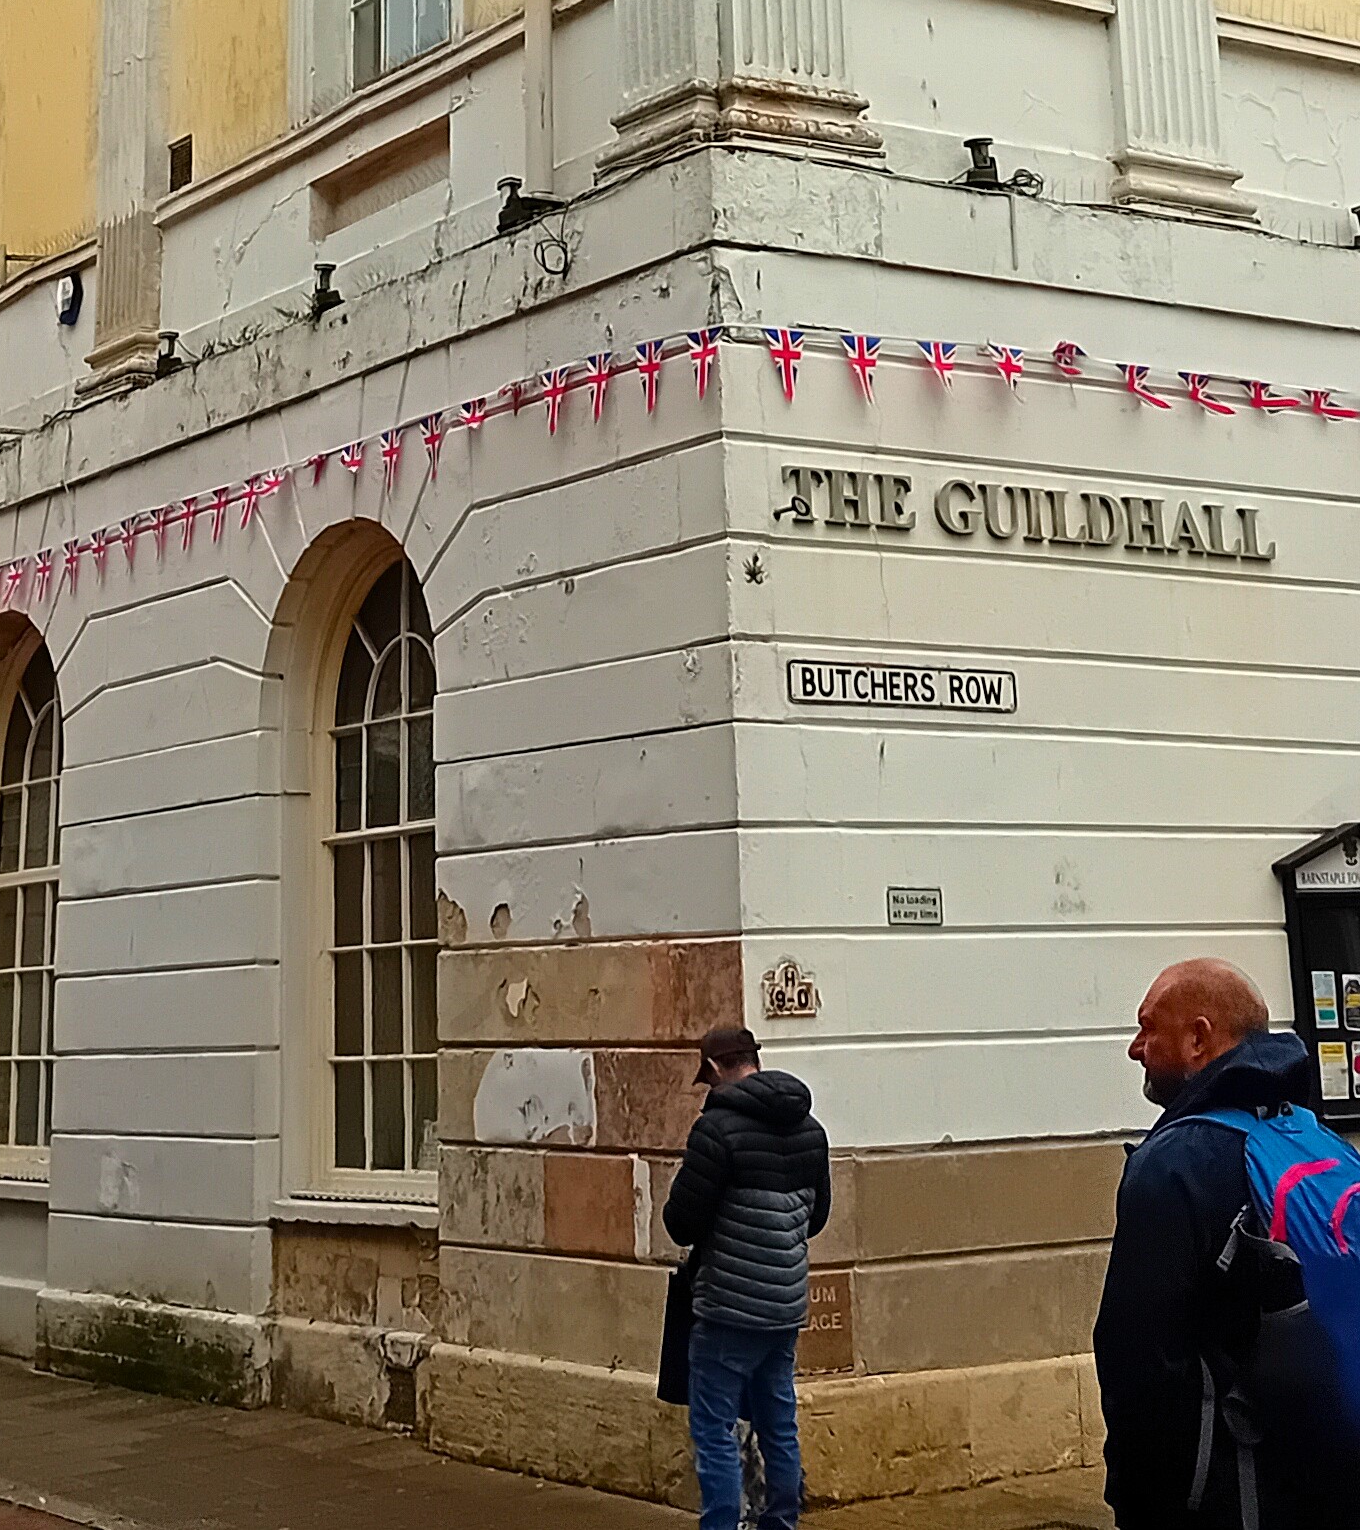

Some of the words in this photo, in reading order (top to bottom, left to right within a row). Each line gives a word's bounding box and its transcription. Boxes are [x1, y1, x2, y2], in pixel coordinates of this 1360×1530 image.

[781, 464, 917, 531] THE
[933, 478, 1277, 562] GUILDHALL
[801, 666, 935, 703] BUTCHERS
[948, 674, 1003, 706] ROW
[1301, 871, 1346, 885] BARNSTAPLE
[892, 894, 905, 904] No
[905, 894, 937, 906] loading
[893, 910, 902, 918] at
[903, 911, 918, 920] any
[920, 910, 938, 918] time
